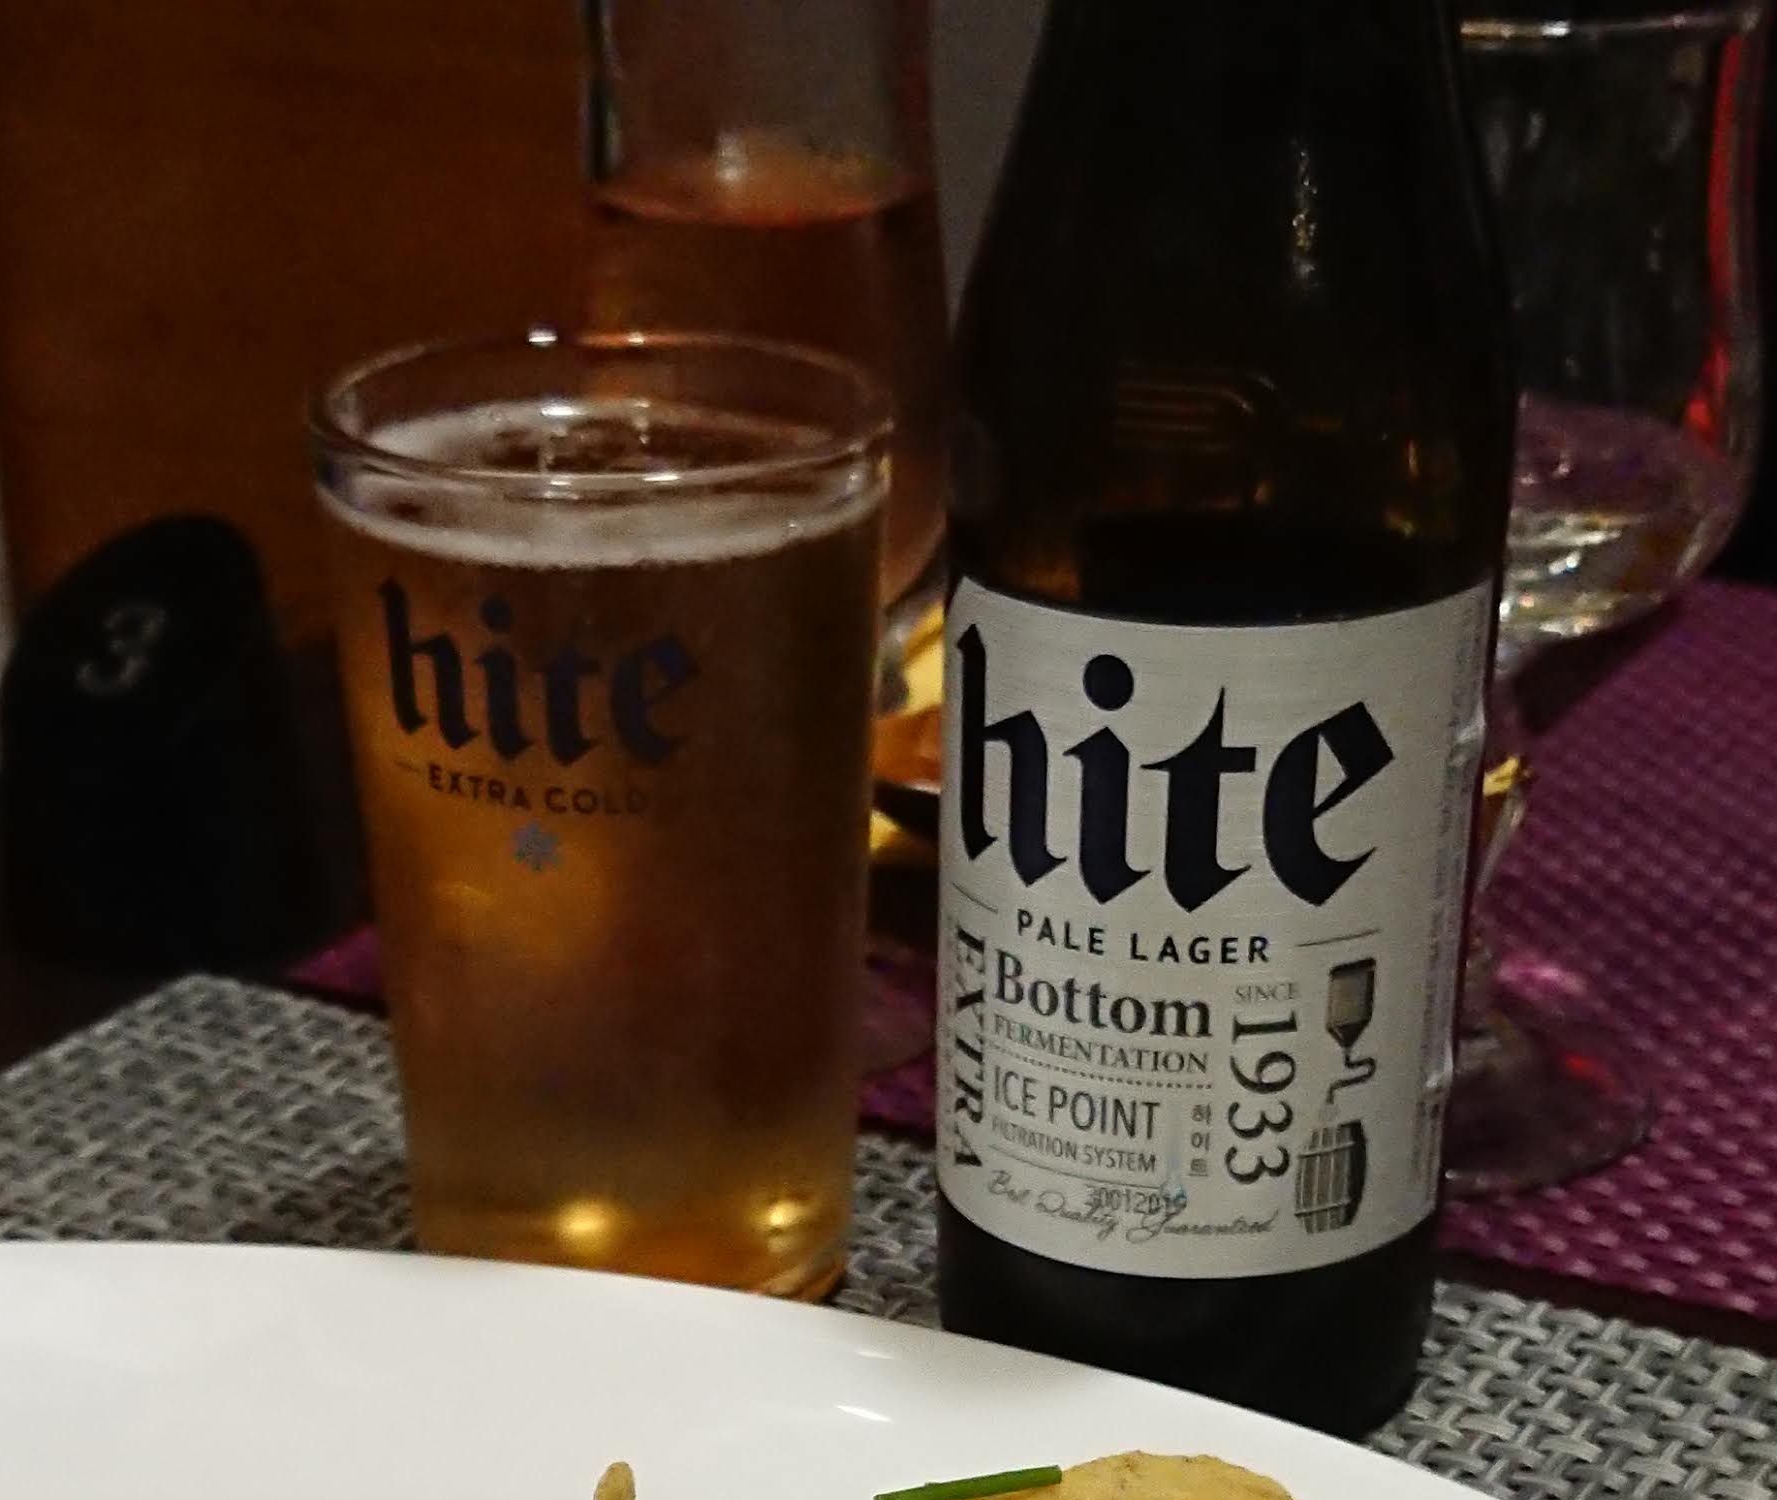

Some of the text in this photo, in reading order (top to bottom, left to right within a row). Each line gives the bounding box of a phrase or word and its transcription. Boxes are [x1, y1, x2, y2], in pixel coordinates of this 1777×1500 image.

[75, 597, 168, 697] 3
[378, 576, 700, 766] hite
[427, 762, 532, 811] EXTRA
[956, 623, 1394, 913] hite
[1017, 908, 1271, 965] PALE LAGER
[995, 947, 1213, 1038] Bottom
[1234, 981, 1299, 1001] SINCE
[954, 923, 986, 1168] EXTRA
[994, 1013, 1209, 1075] FERMENTATION
[993, 1065, 1161, 1140] ICE POINT
[1225, 1009, 1298, 1185] 1933
[991, 1114, 1157, 1174] FILTRATION SYSTEM
